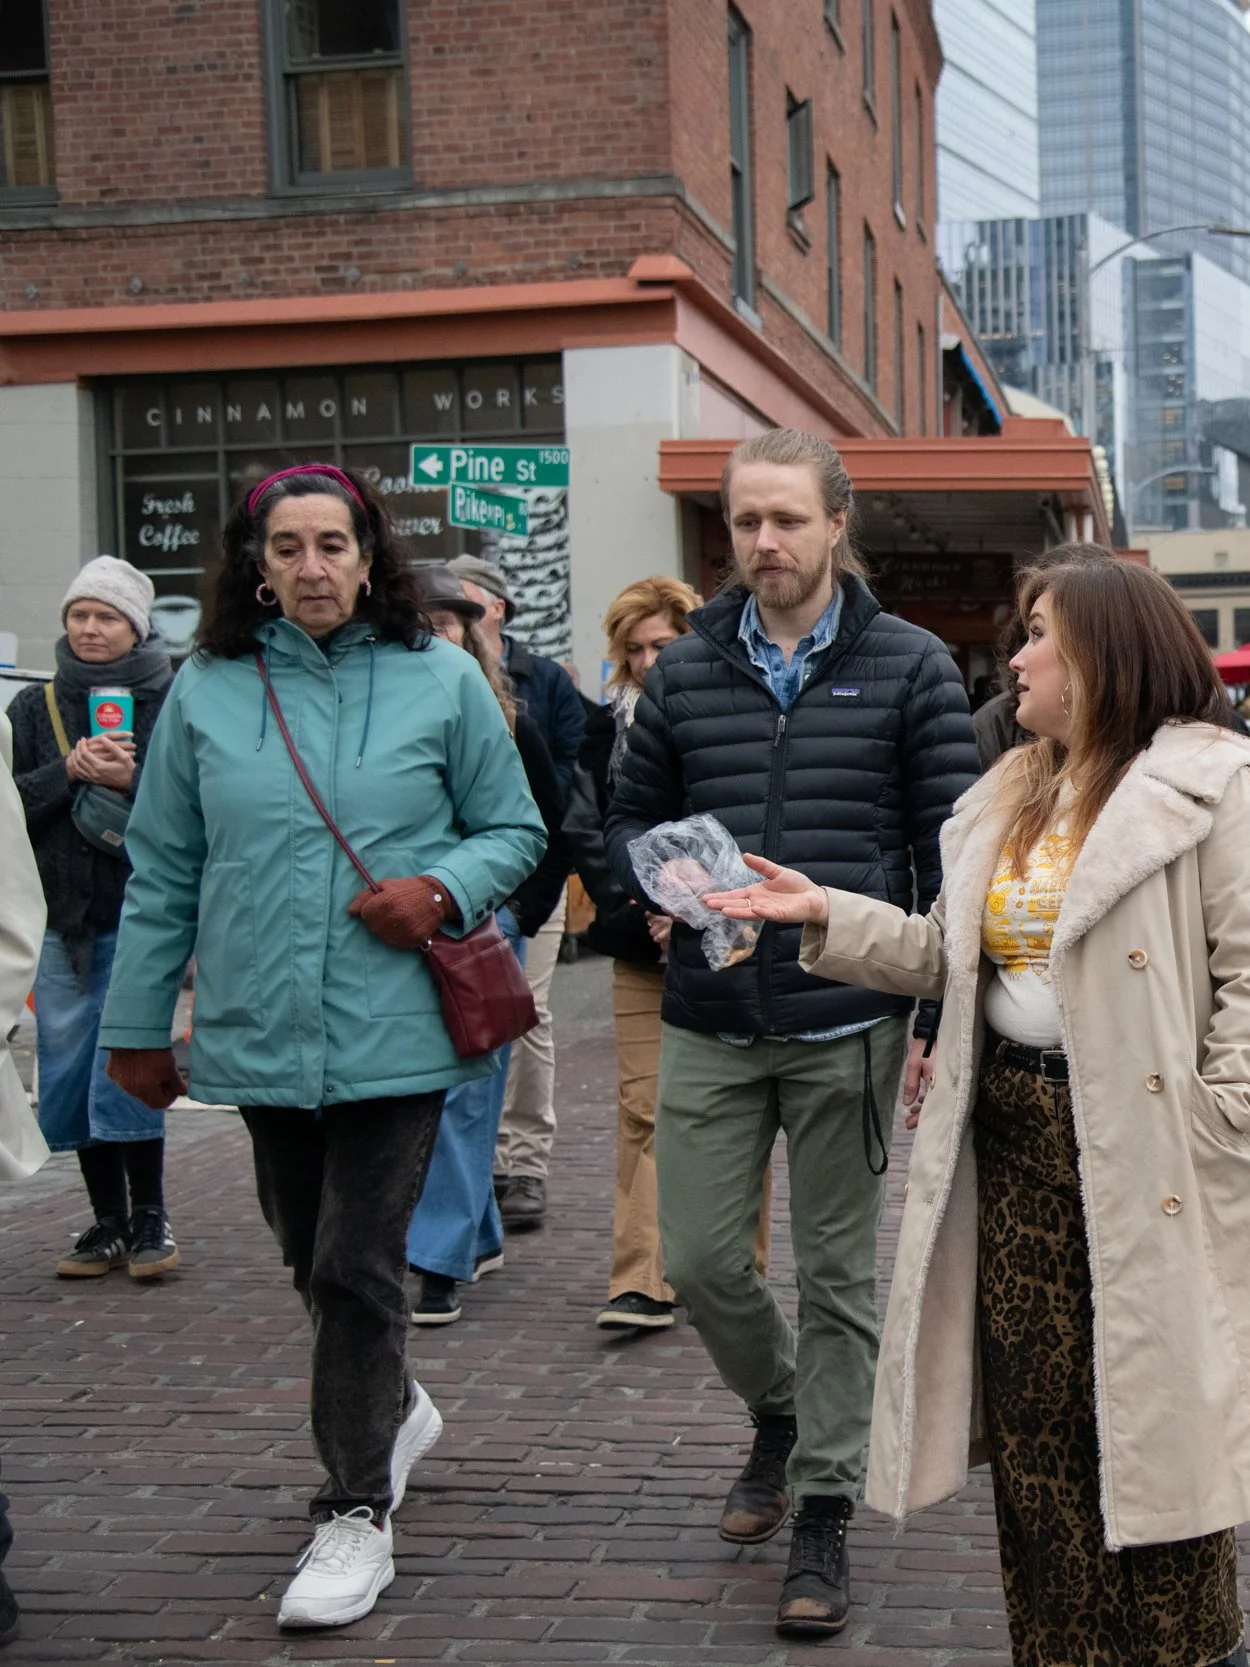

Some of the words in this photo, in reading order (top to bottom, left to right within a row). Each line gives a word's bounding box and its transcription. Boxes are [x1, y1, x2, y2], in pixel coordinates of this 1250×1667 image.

[145, 397, 367, 427] CINNAMON
[433, 384, 564, 411] WORKS
[451, 449, 505, 482] Pine
[516, 458, 537, 482] St
[539, 450, 569, 465] 1500
[455, 486, 488, 525] Pike
[139, 522, 200, 552] Coffee
